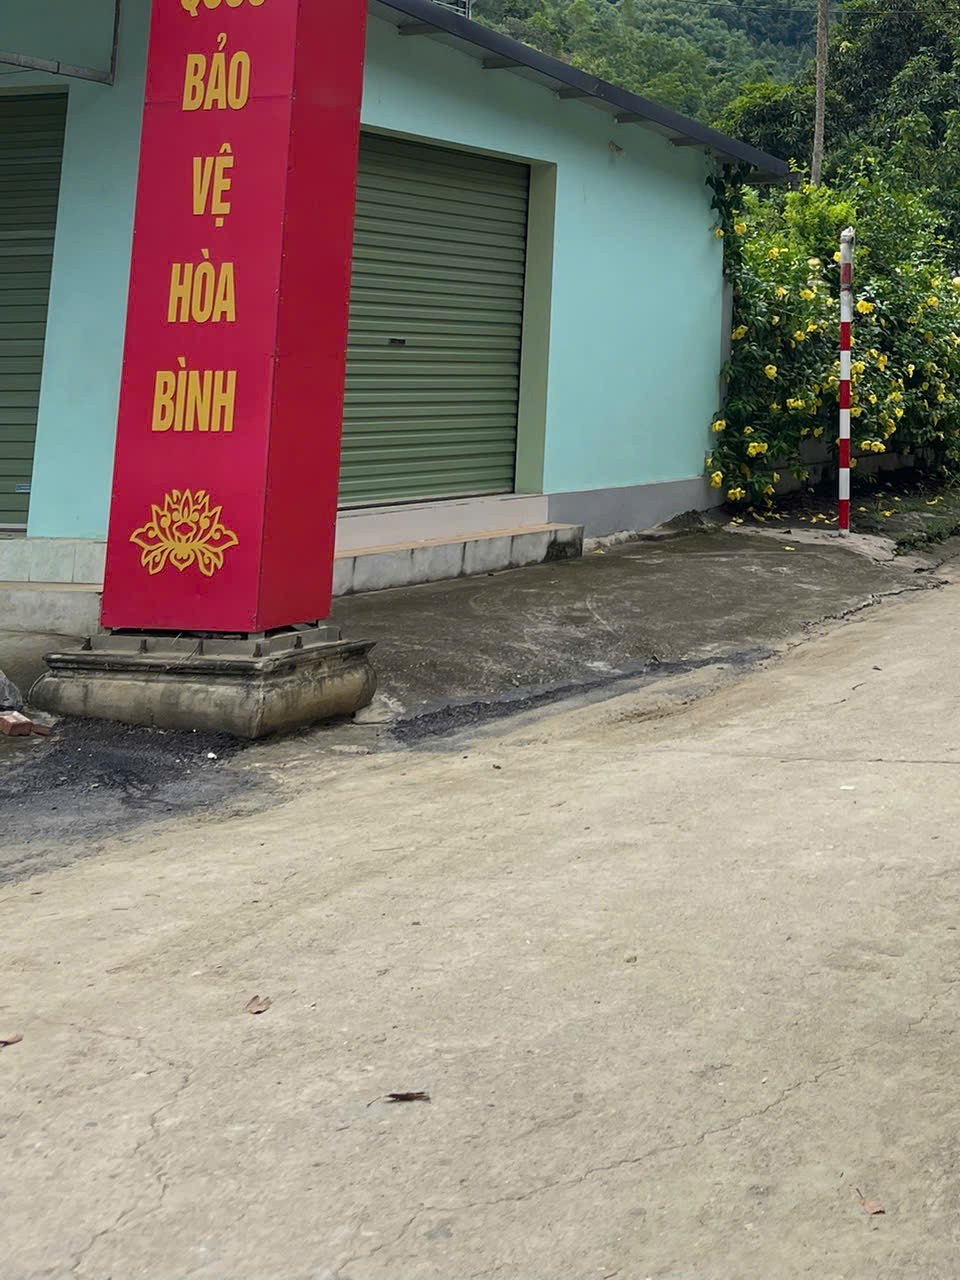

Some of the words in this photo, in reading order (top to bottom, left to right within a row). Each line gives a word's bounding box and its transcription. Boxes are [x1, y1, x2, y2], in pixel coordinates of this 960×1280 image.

[182, 32, 251, 111] BẢO
[192, 143, 235, 227] VỆ
[167, 249, 236, 323] HÒA
[151, 358, 237, 432] BÌNH
